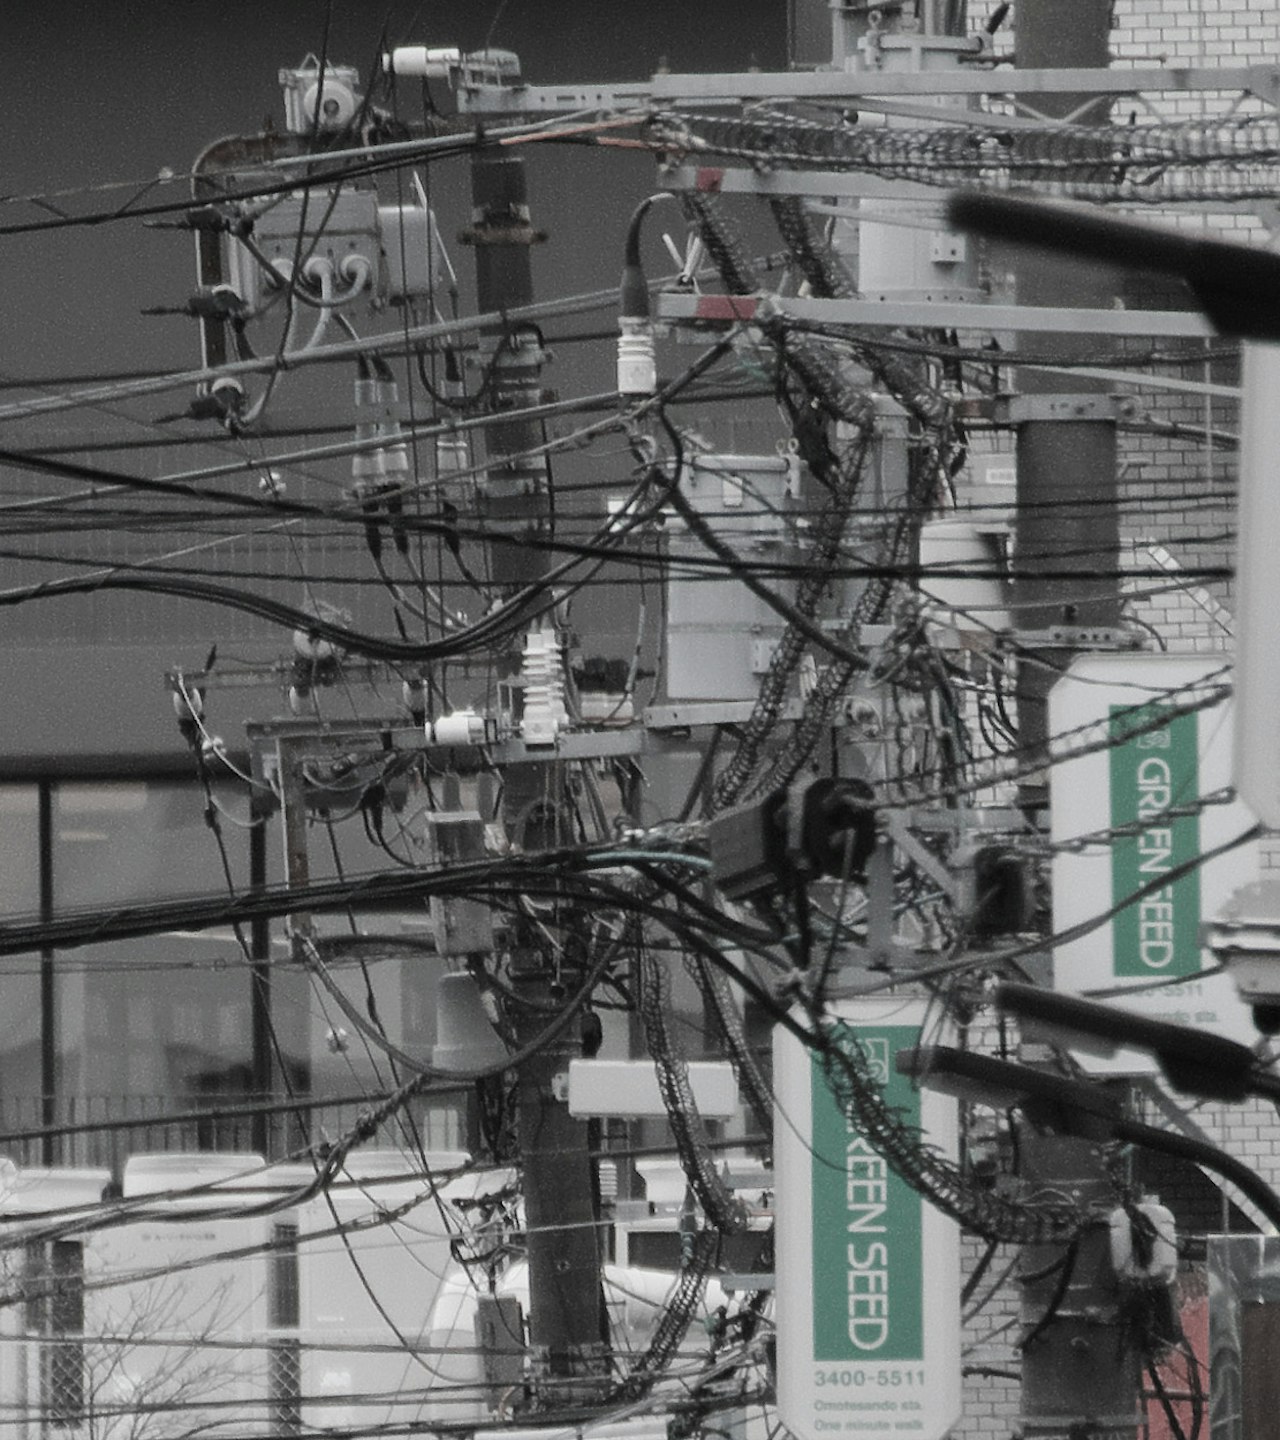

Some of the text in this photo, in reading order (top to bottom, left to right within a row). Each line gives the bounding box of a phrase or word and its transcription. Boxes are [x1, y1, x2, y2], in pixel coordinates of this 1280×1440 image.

[847, 1242, 889, 1350] SEED
[815, 1369, 925, 1387] 3400-5511
[814, 1400, 898, 1411] Omotesando
[814, 1420, 841, 1431] One
